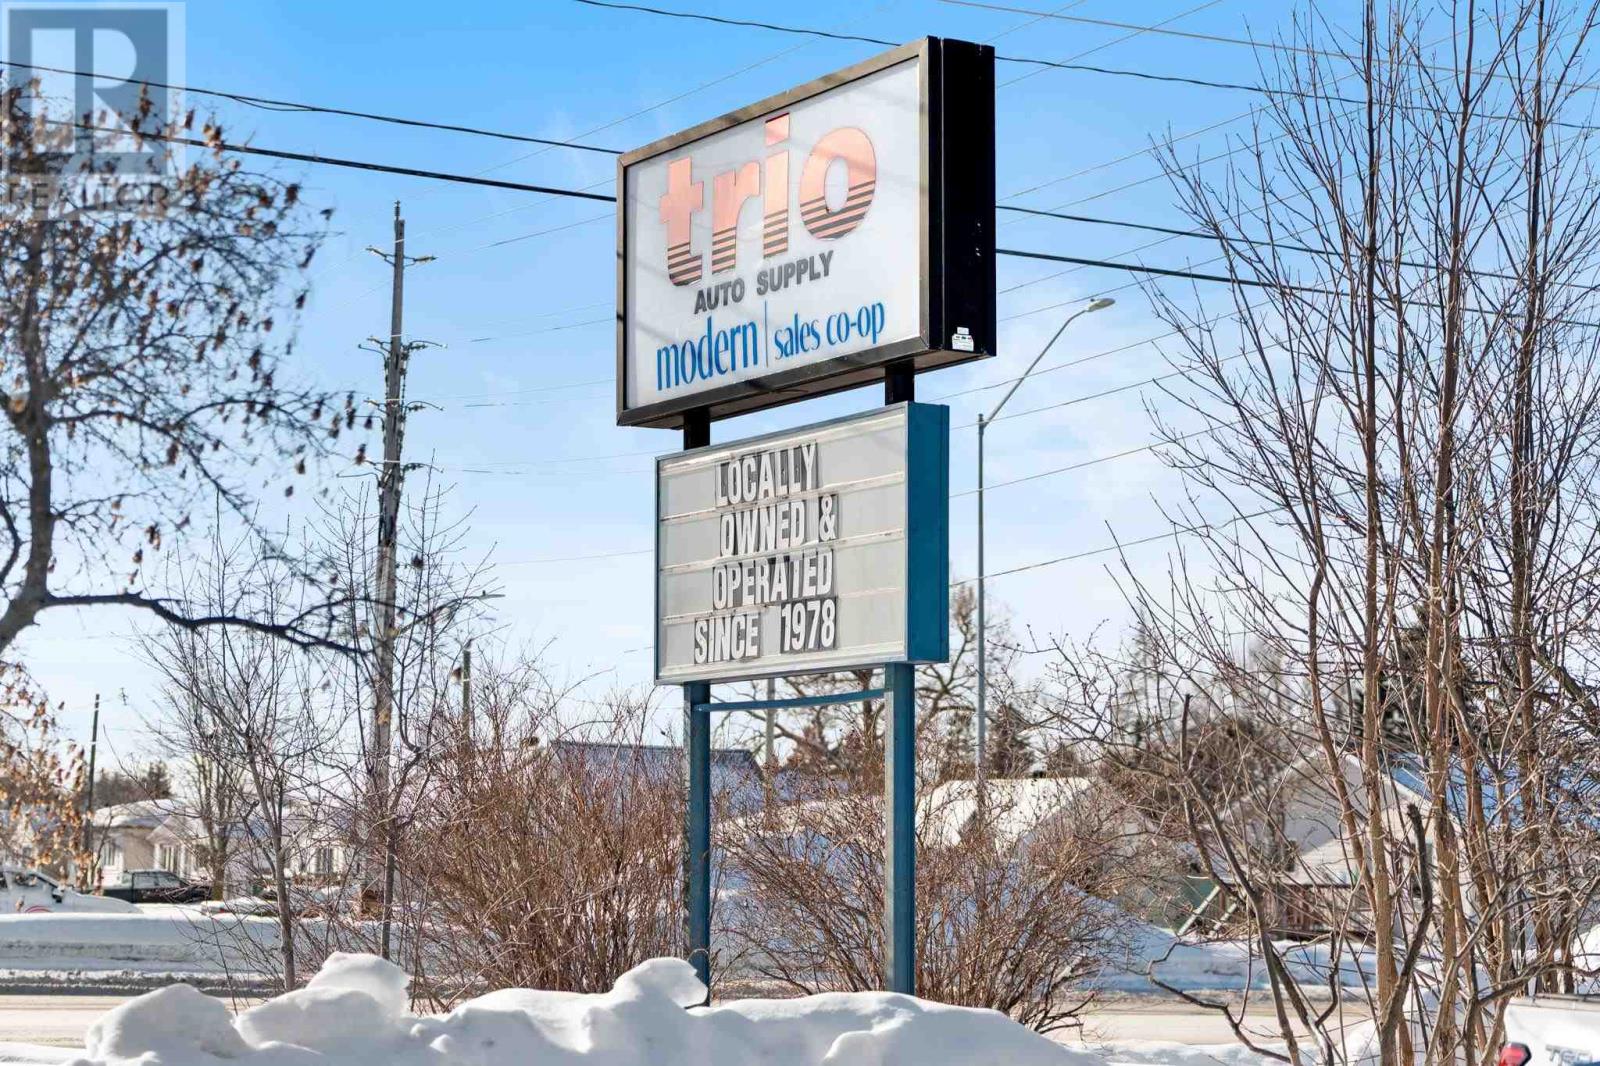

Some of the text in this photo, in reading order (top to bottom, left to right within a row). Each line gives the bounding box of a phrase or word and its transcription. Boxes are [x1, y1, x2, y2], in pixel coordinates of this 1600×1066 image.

[660, 112, 876, 287] trio
[694, 250, 833, 315] AUTO SUPPLY
[656, 300, 885, 391] modern sales co-op
[716, 443, 817, 506] LOCALLY
[721, 494, 836, 557] OWNED &
[713, 550, 834, 610] OPERATED
[694, 599, 836, 664] SINCE 1978
